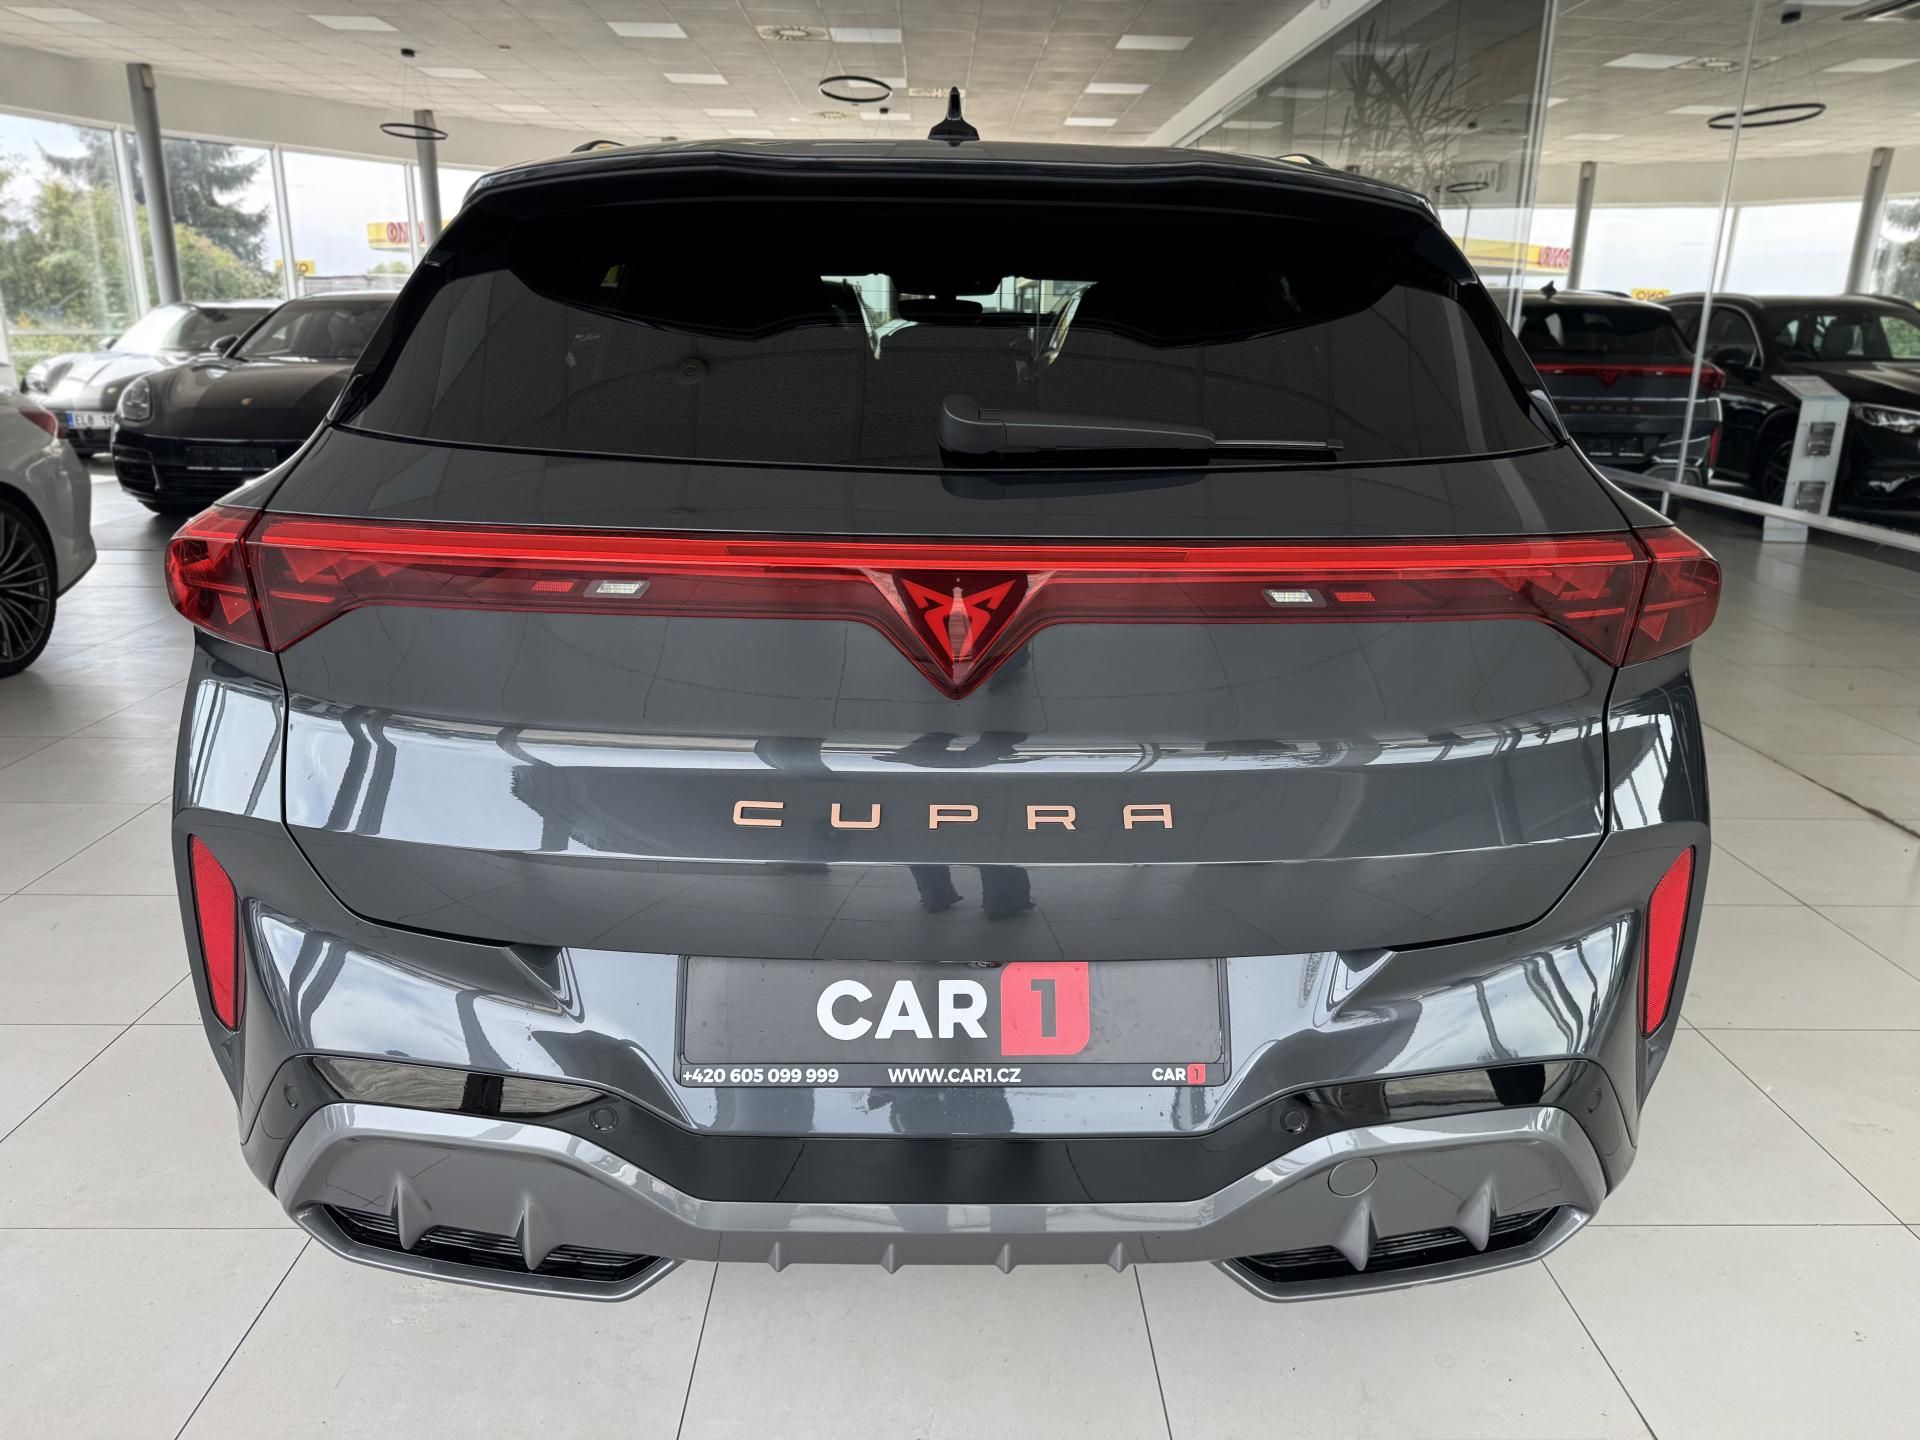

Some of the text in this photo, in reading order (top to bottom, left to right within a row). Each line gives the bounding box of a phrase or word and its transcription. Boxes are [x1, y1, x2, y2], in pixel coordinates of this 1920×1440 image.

[732, 800, 1174, 830] CUPRA
[682, 1068, 840, 1084] +420 605 099 999
[887, 1067, 1023, 1084] WWW.CAR1.CZ
